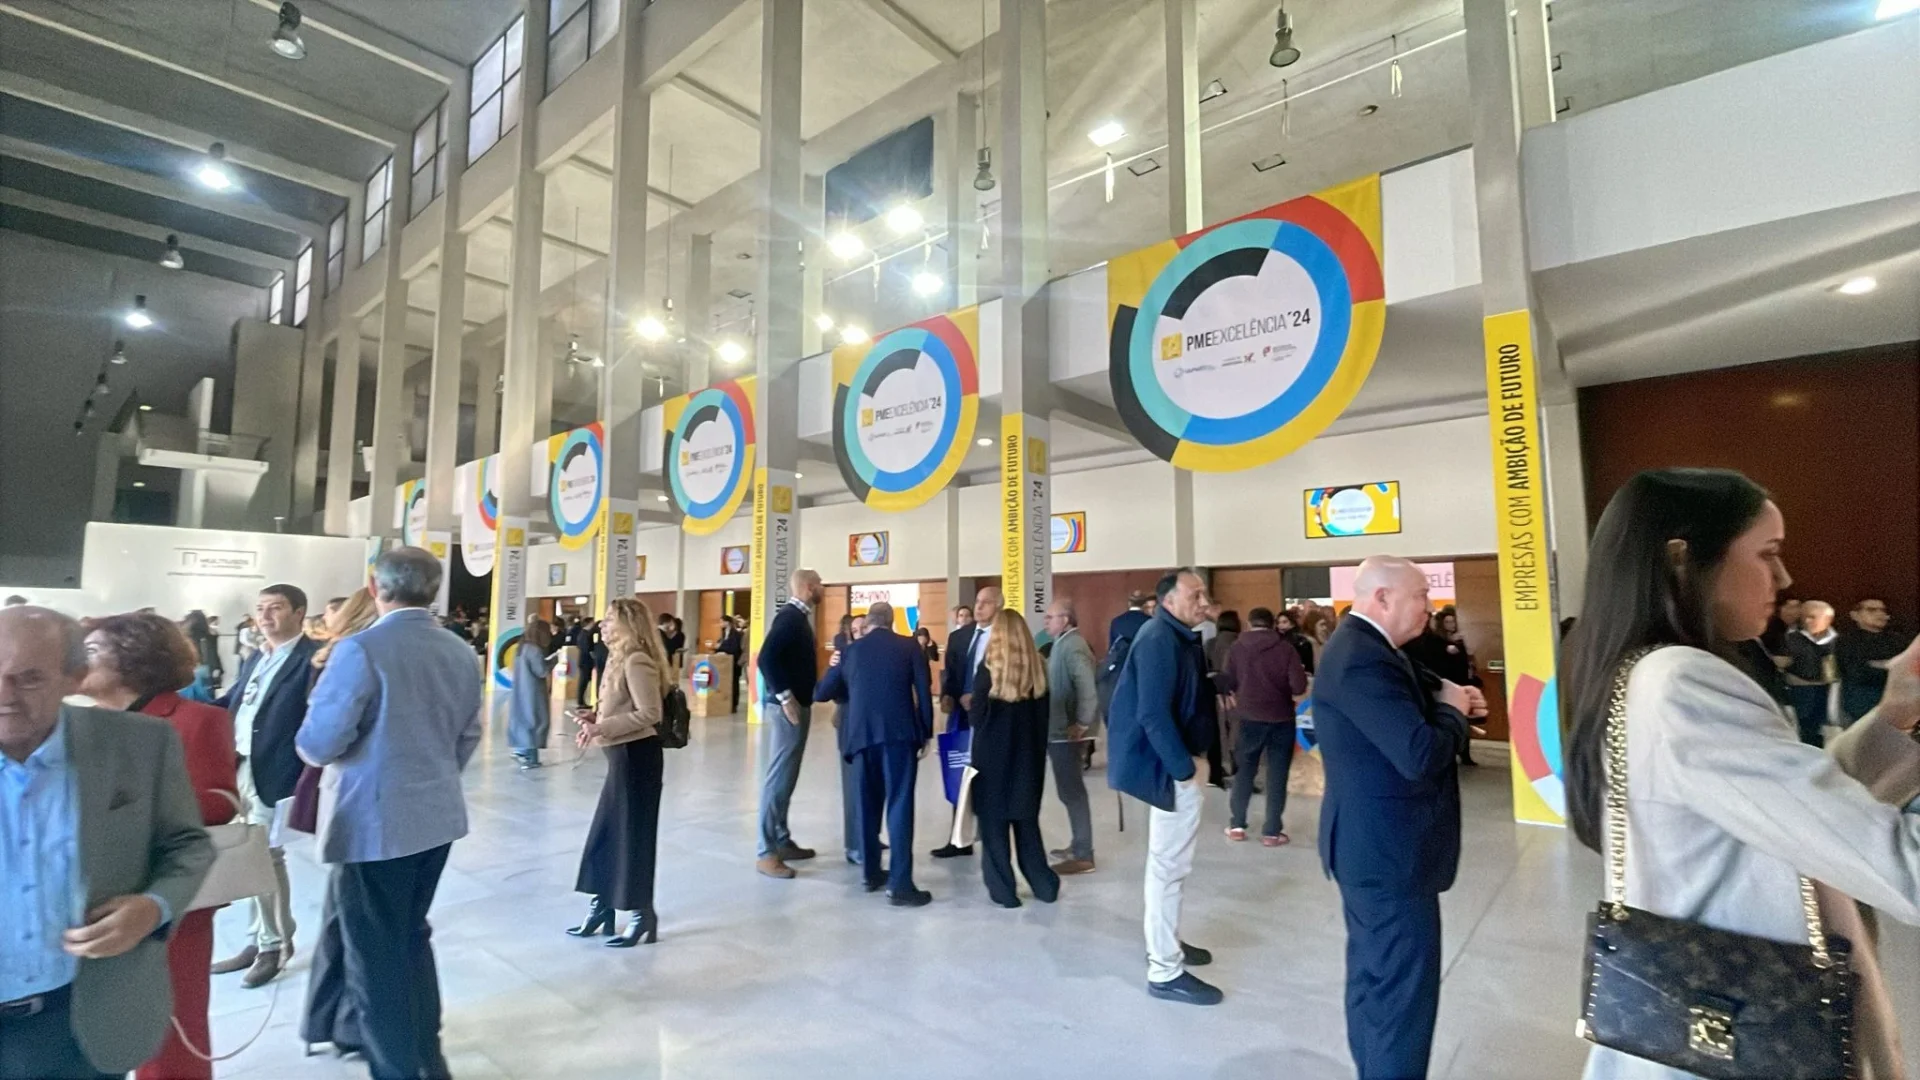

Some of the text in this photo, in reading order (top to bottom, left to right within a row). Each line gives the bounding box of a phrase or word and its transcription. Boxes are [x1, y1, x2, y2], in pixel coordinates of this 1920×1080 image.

[1005, 434, 1020, 608] MPRESAS COM AMBIÇÃO DE FUTURO
[1498, 344, 1539, 611] EMPRESAS COM AMBIÇÃO DE FUTURO
